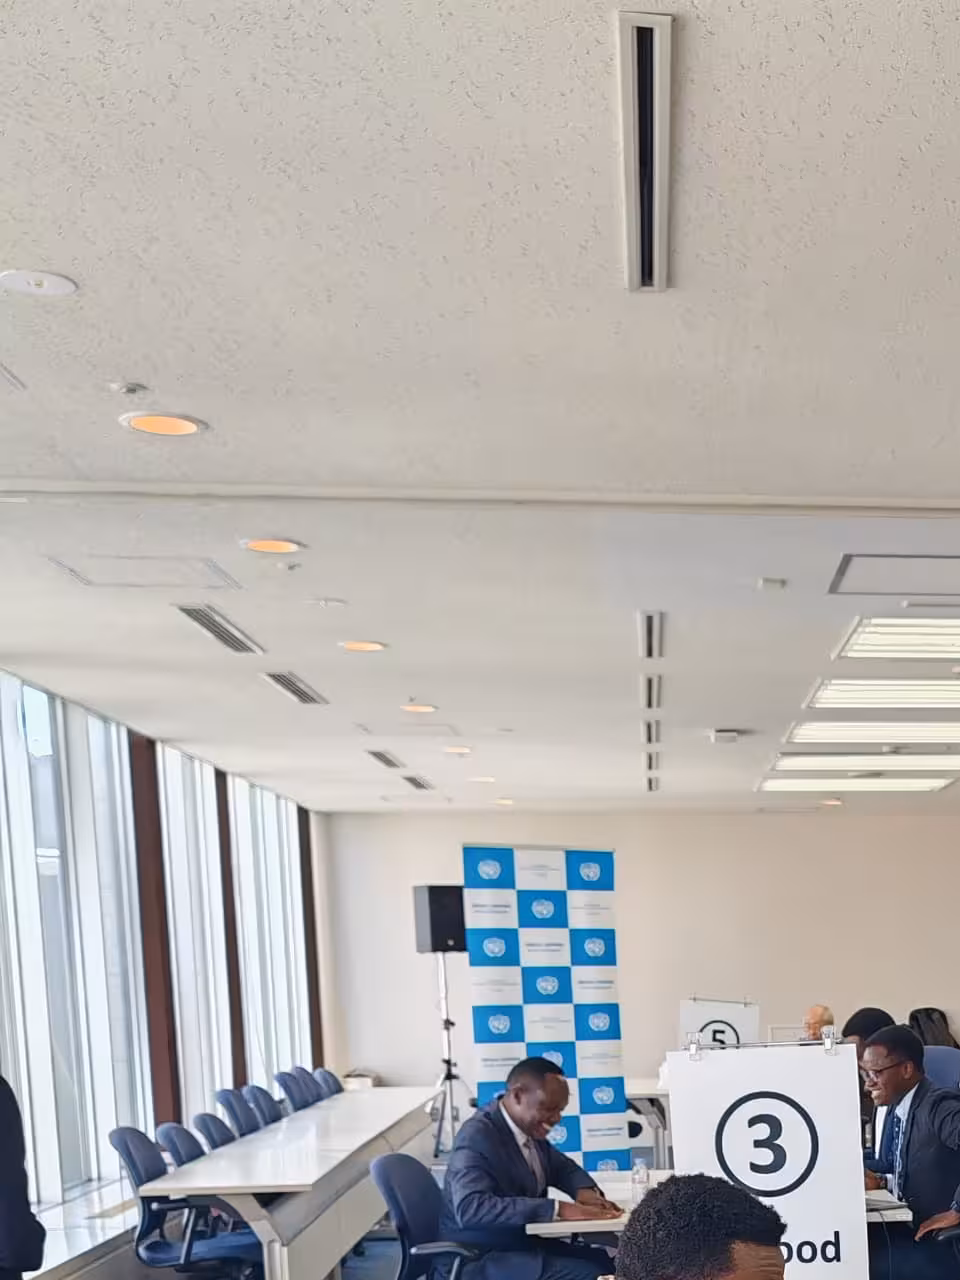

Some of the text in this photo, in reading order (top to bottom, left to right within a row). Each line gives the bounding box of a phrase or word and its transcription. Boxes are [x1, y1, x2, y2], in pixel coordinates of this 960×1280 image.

[711, 1030, 726, 1049] 5
[747, 1113, 787, 1174] 3
[778, 1230, 841, 1264] ood
